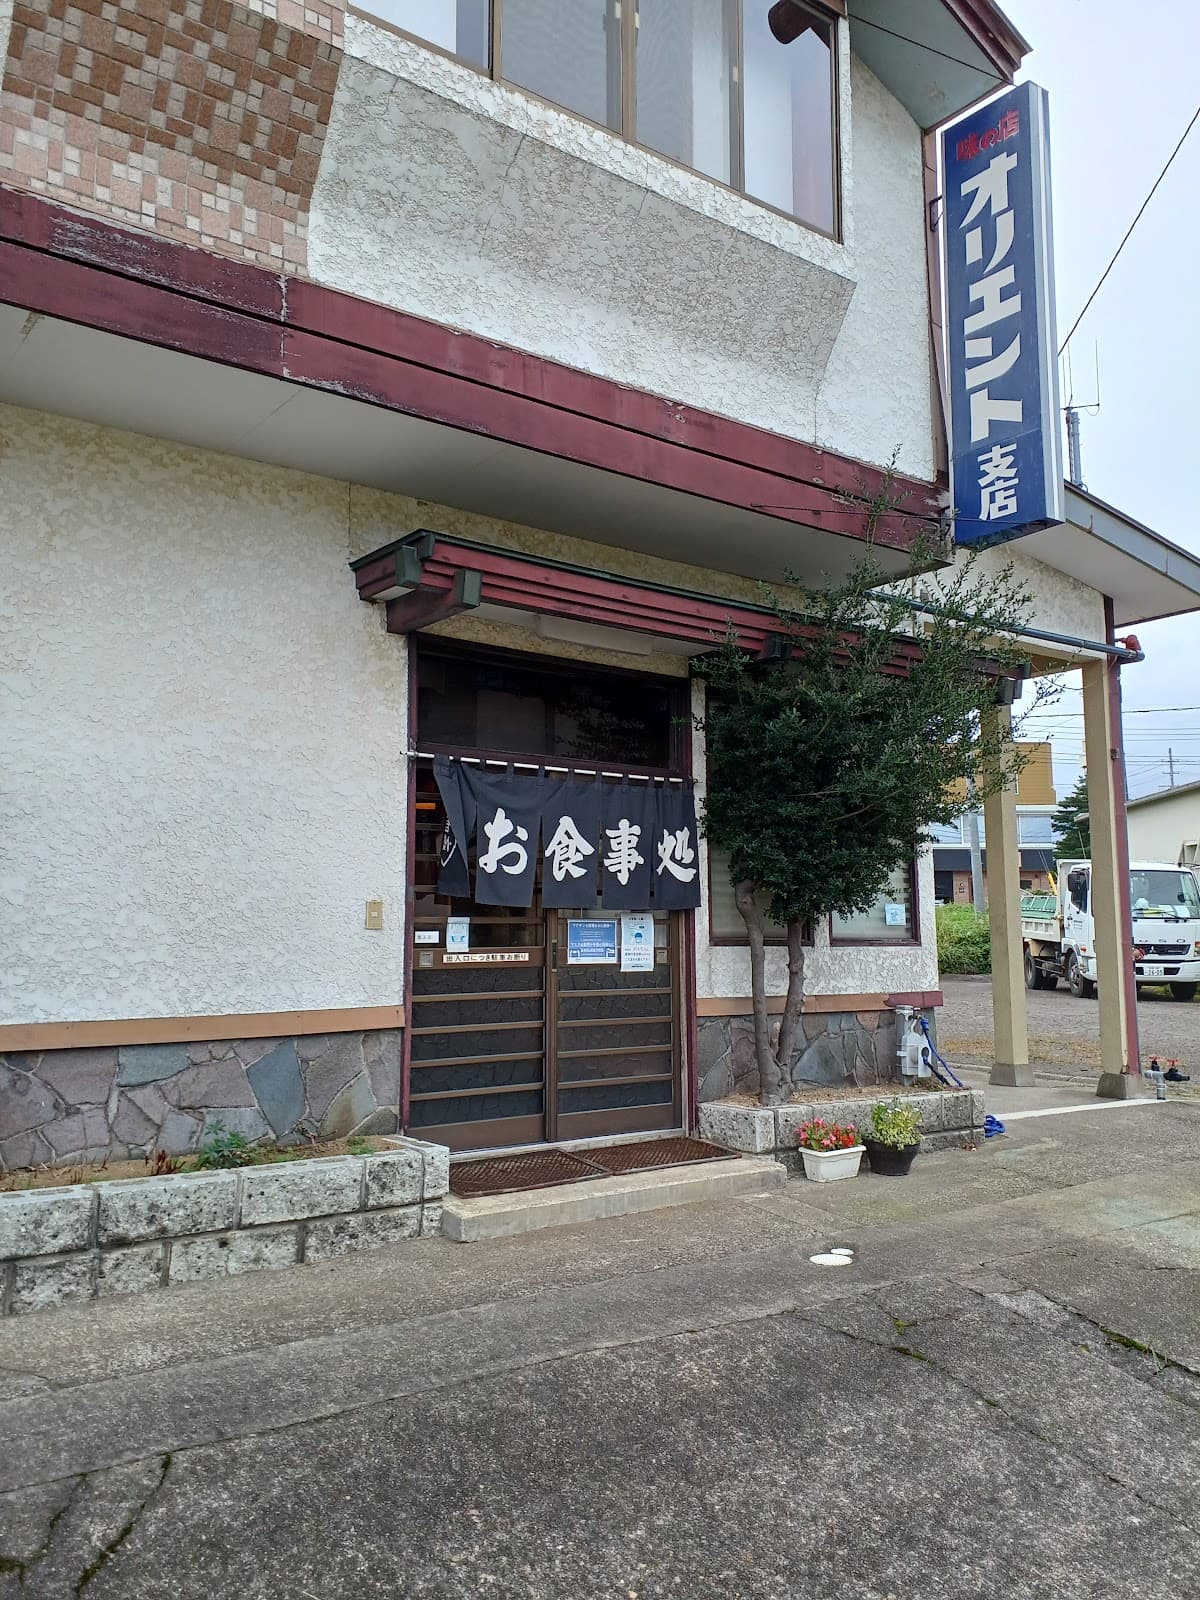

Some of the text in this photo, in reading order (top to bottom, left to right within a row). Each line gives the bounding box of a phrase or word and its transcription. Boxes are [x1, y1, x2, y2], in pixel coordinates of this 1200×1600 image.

[956, 111, 1020, 161] 味の店
[478, 807, 698, 886] お食事処
